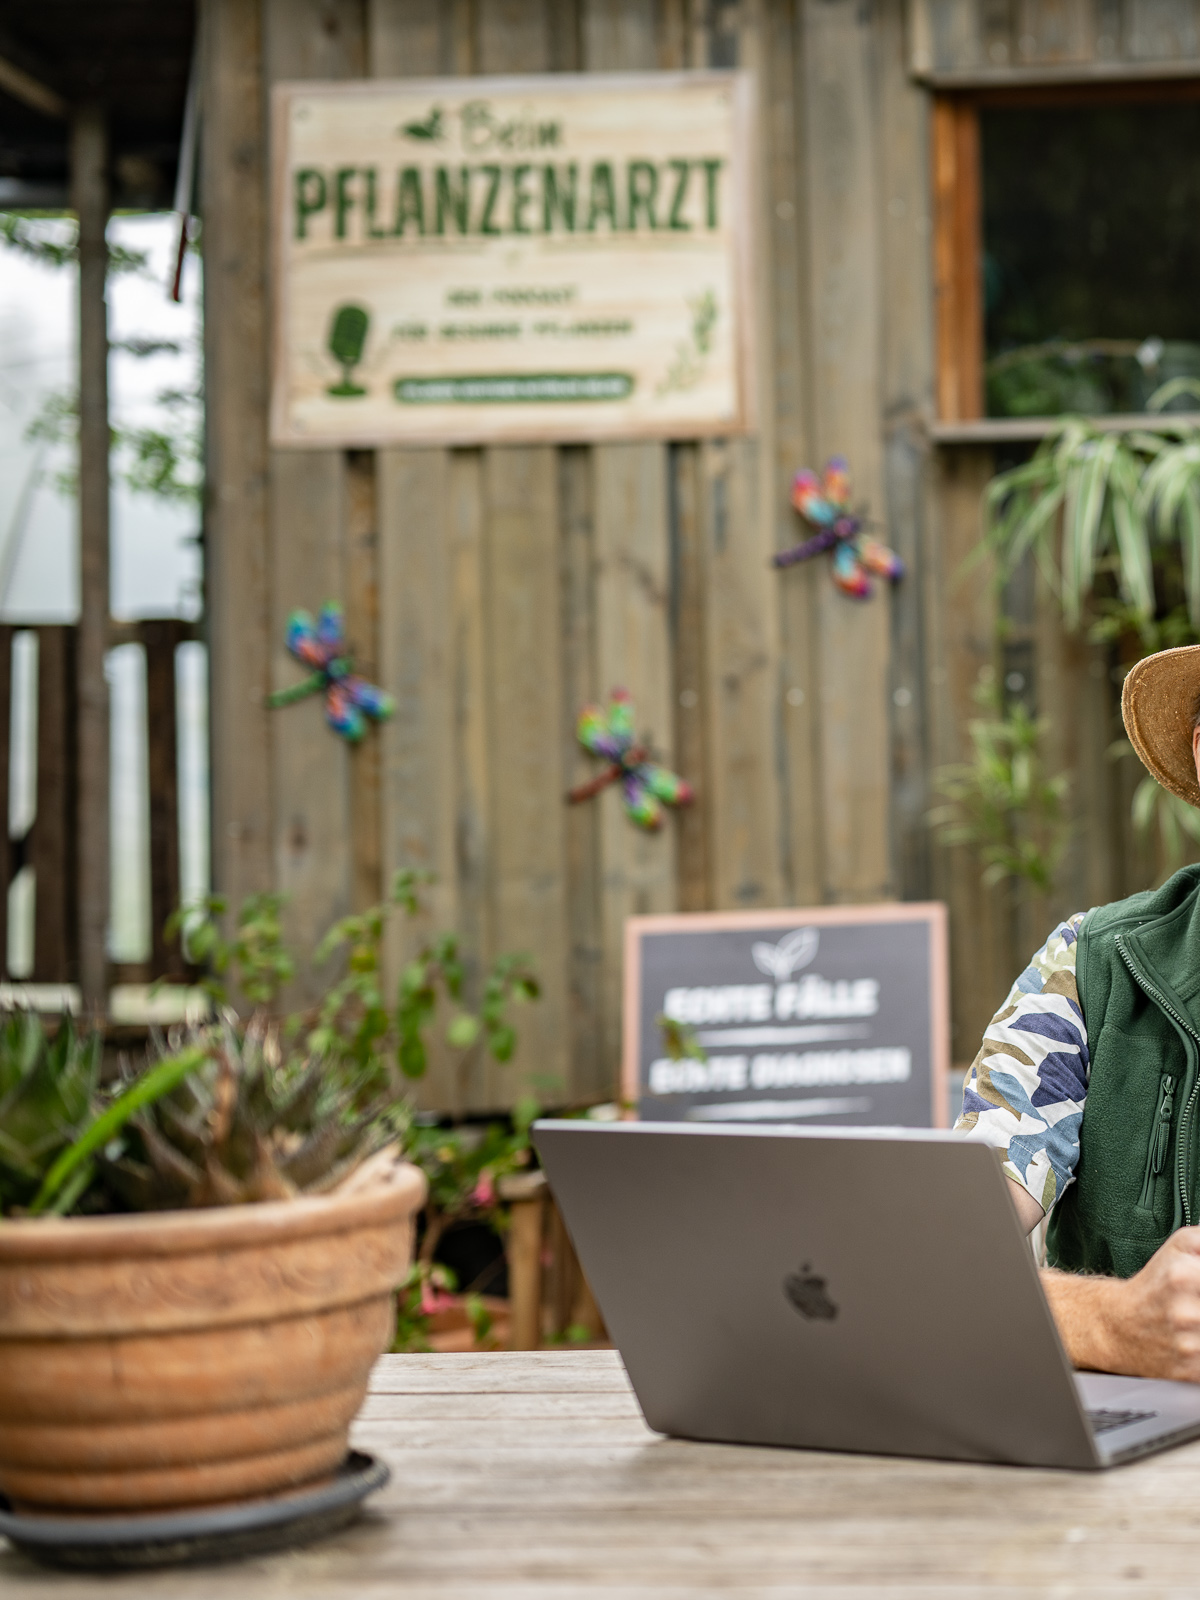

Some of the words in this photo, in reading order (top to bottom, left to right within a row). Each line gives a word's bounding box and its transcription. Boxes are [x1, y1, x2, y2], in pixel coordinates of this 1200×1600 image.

[461, 101, 564, 152] Beim
[294, 158, 724, 241] PFLANZENARZT
[776, 974, 880, 1019] FÄLLE
